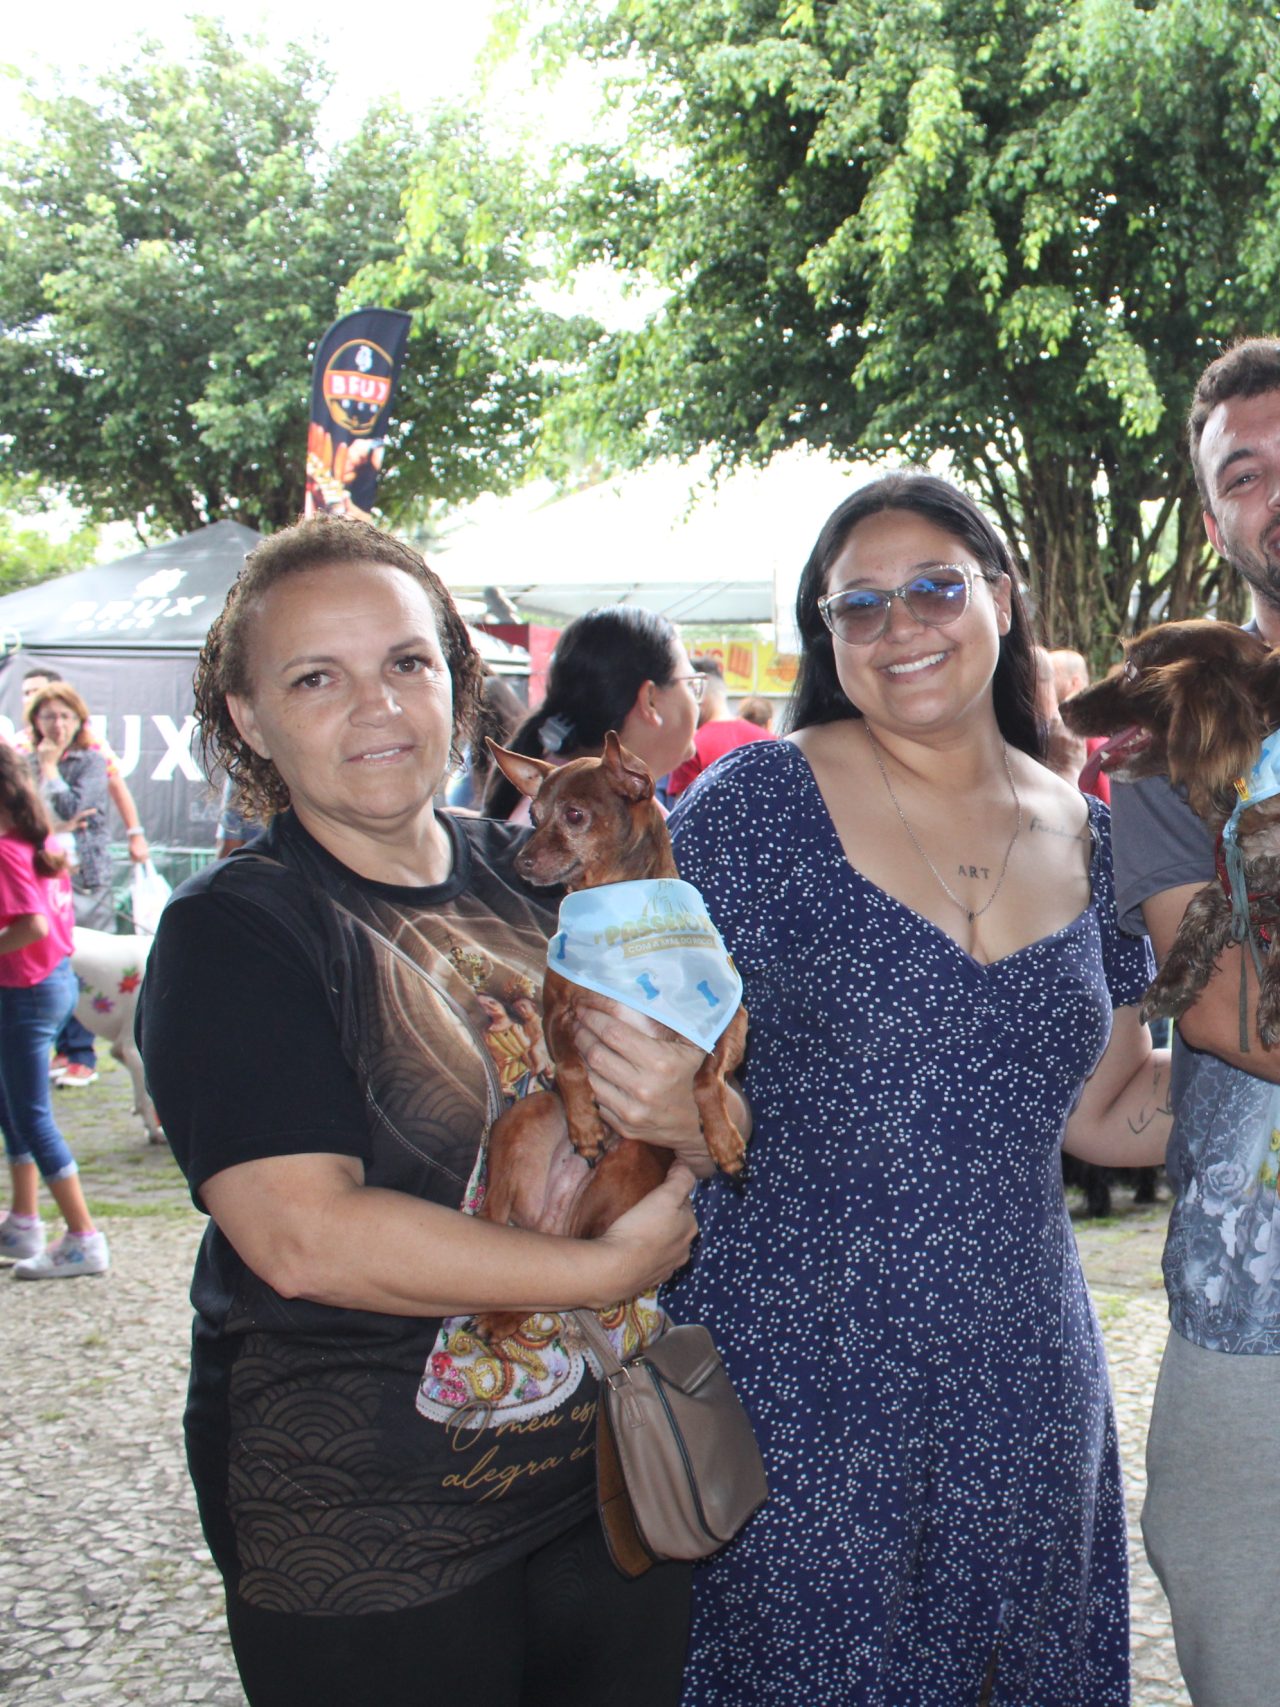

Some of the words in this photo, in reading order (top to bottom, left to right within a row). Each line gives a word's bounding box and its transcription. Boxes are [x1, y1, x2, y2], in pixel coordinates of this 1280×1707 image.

[958, 864, 990, 880] ART
[445, 1400, 492, 1451] O
[496, 1410, 564, 1437] meu
[441, 1444, 563, 1502] alegra
